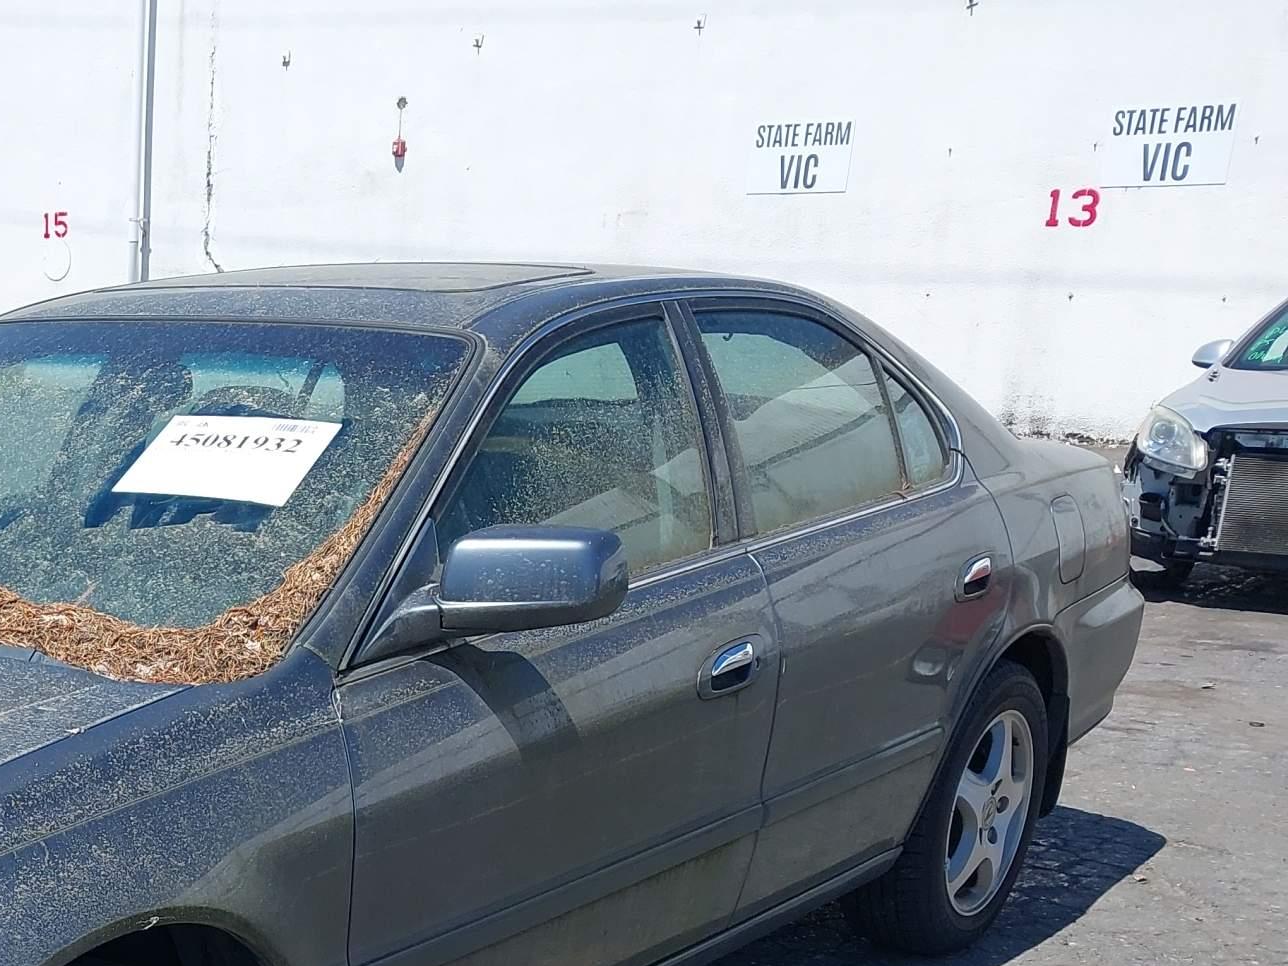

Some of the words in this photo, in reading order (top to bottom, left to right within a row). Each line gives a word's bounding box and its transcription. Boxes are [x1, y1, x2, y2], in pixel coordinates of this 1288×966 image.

[755, 123, 801, 149] STATE
[804, 121, 852, 147] FARM
[1112, 107, 1171, 136] STATE
[1173, 103, 1237, 133] FARM
[779, 153, 820, 190] VIC
[1142, 141, 1193, 182] VIC
[1044, 187, 1100, 228] 13
[42, 210, 69, 240] 15
[170, 432, 303, 453] 45081932
